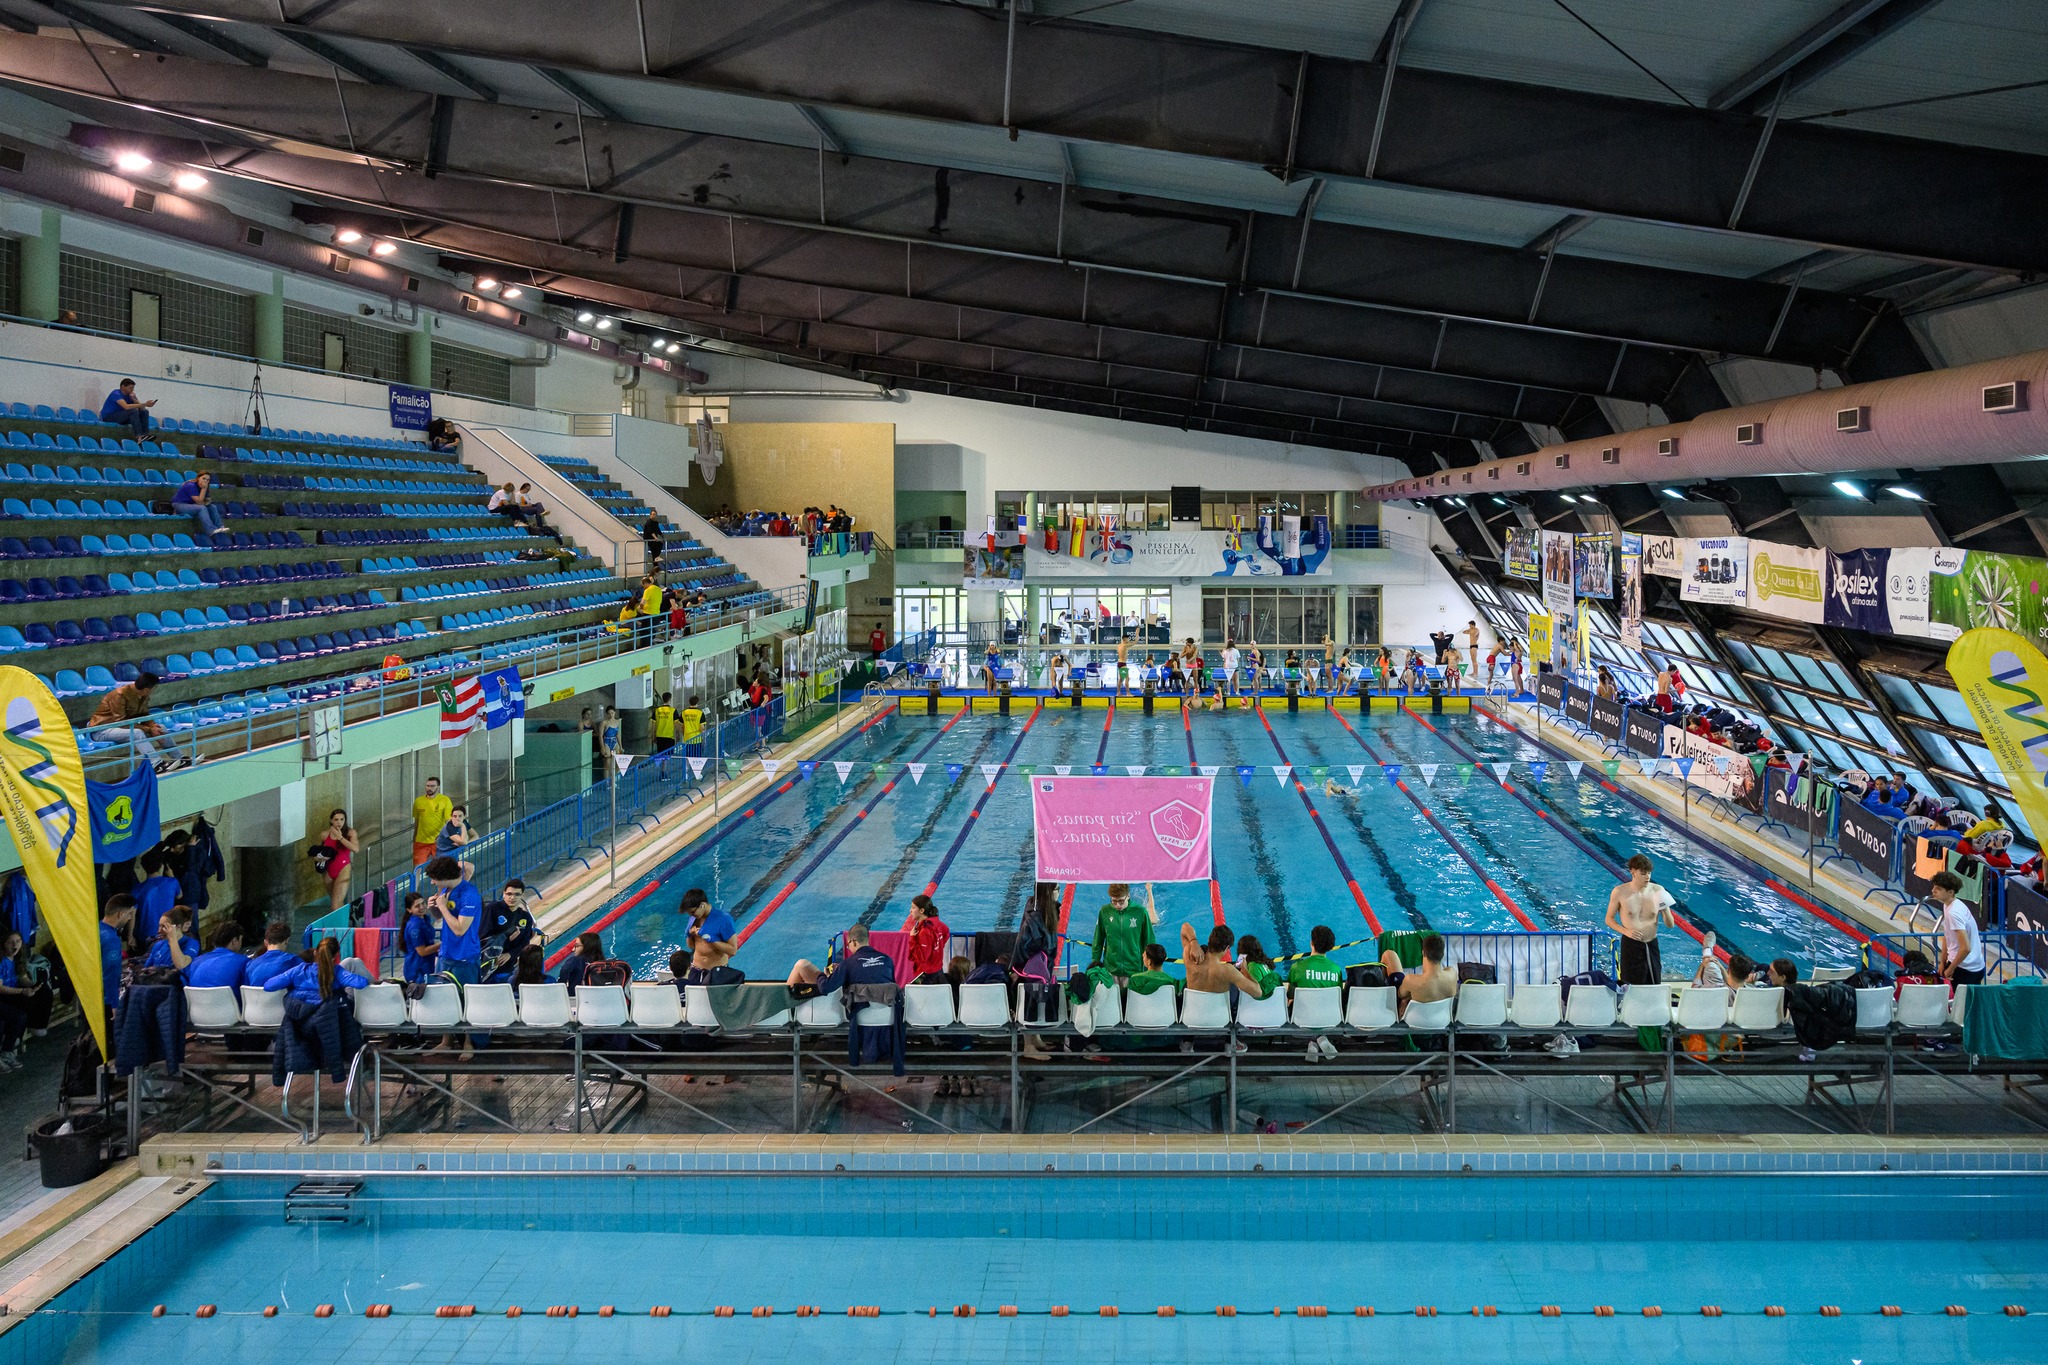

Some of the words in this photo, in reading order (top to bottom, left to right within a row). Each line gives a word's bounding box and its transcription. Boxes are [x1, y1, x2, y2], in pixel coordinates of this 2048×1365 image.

[391, 391, 430, 409] Famalicão
[1652, 538, 1675, 560] FOCA
[1772, 572, 1796, 588] Quinta
[1865, 598, 1878, 607] auto
[1546, 685, 1561, 699] TURBO
[1573, 698, 1588, 712] TURBO
[1601, 711, 1620, 727] TURBO
[1637, 726, 1657, 744] TURBO
[1855, 825, 1888, 859] TURBO
[1305, 969, 1339, 983] Fluvial
